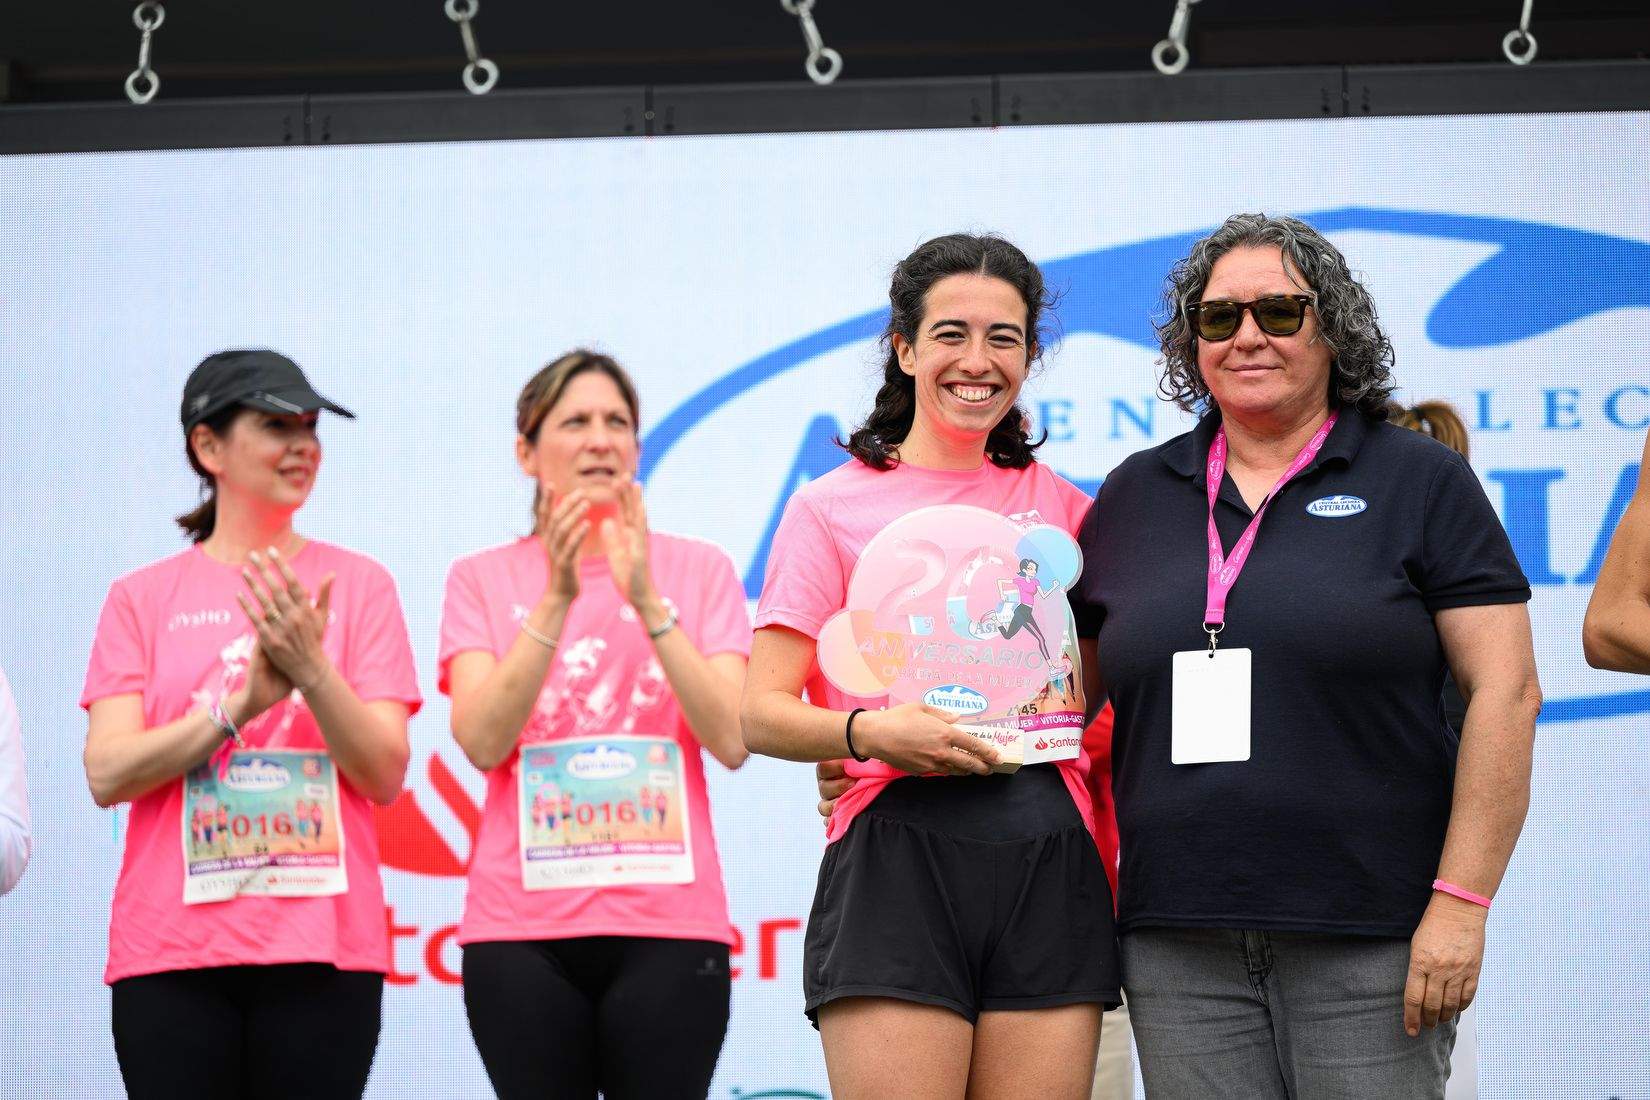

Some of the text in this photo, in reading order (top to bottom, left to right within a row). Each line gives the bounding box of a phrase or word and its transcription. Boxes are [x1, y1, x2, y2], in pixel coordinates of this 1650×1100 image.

[1311, 503, 1362, 512] ASTURIANA
[856, 638, 1044, 670] ANIVERSARIO
[928, 694, 984, 710] ASTURIANA
[1004, 719, 1034, 731] MUJER
[993, 730, 1020, 746] Mujer
[1049, 736, 1081, 748] Santan
[576, 800, 638, 826] 016
[232, 812, 294, 837] 016
